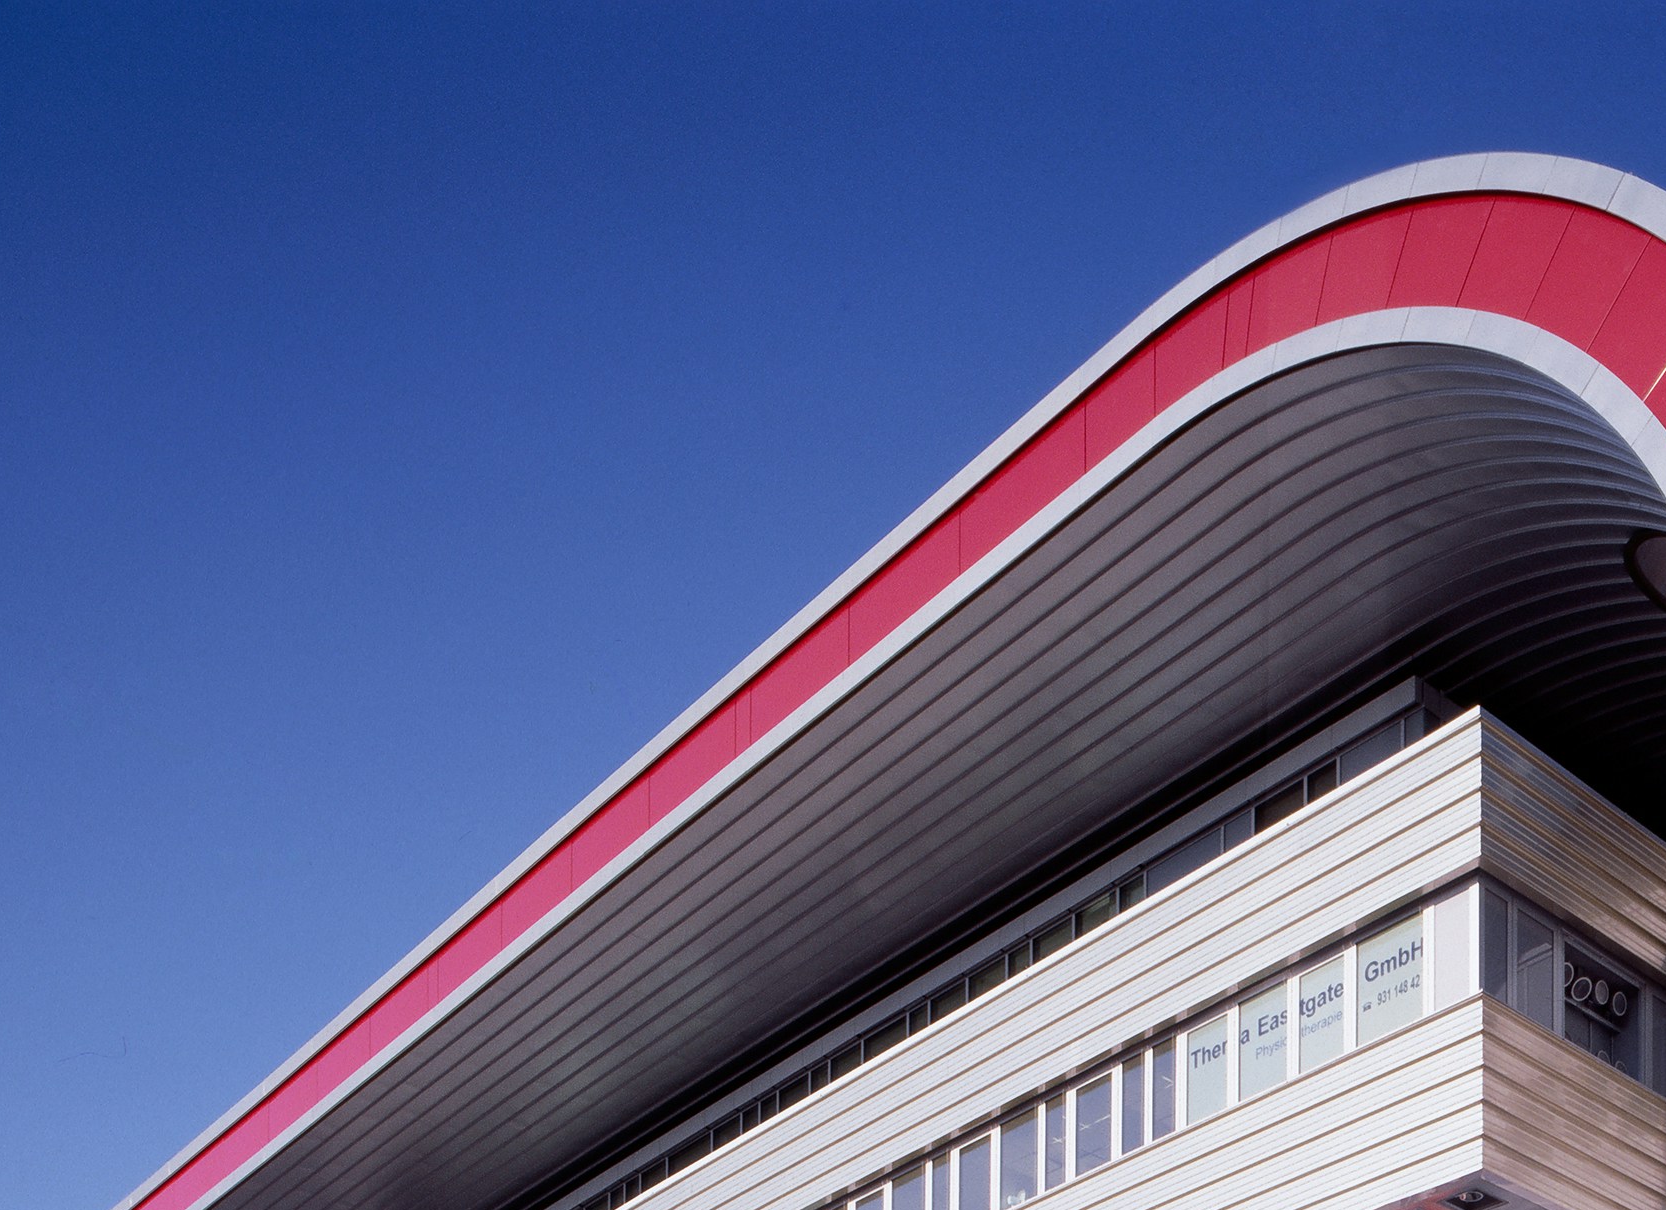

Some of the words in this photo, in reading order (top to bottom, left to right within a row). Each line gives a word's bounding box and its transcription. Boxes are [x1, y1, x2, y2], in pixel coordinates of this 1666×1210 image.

[1258, 981, 1344, 1037] Eastgate
[1364, 937, 1424, 983] GmbH
[1376, 990, 1391, 1006] 931
[1394, 981, 1409, 1000] 148
[1410, 973, 1421, 990] 42
